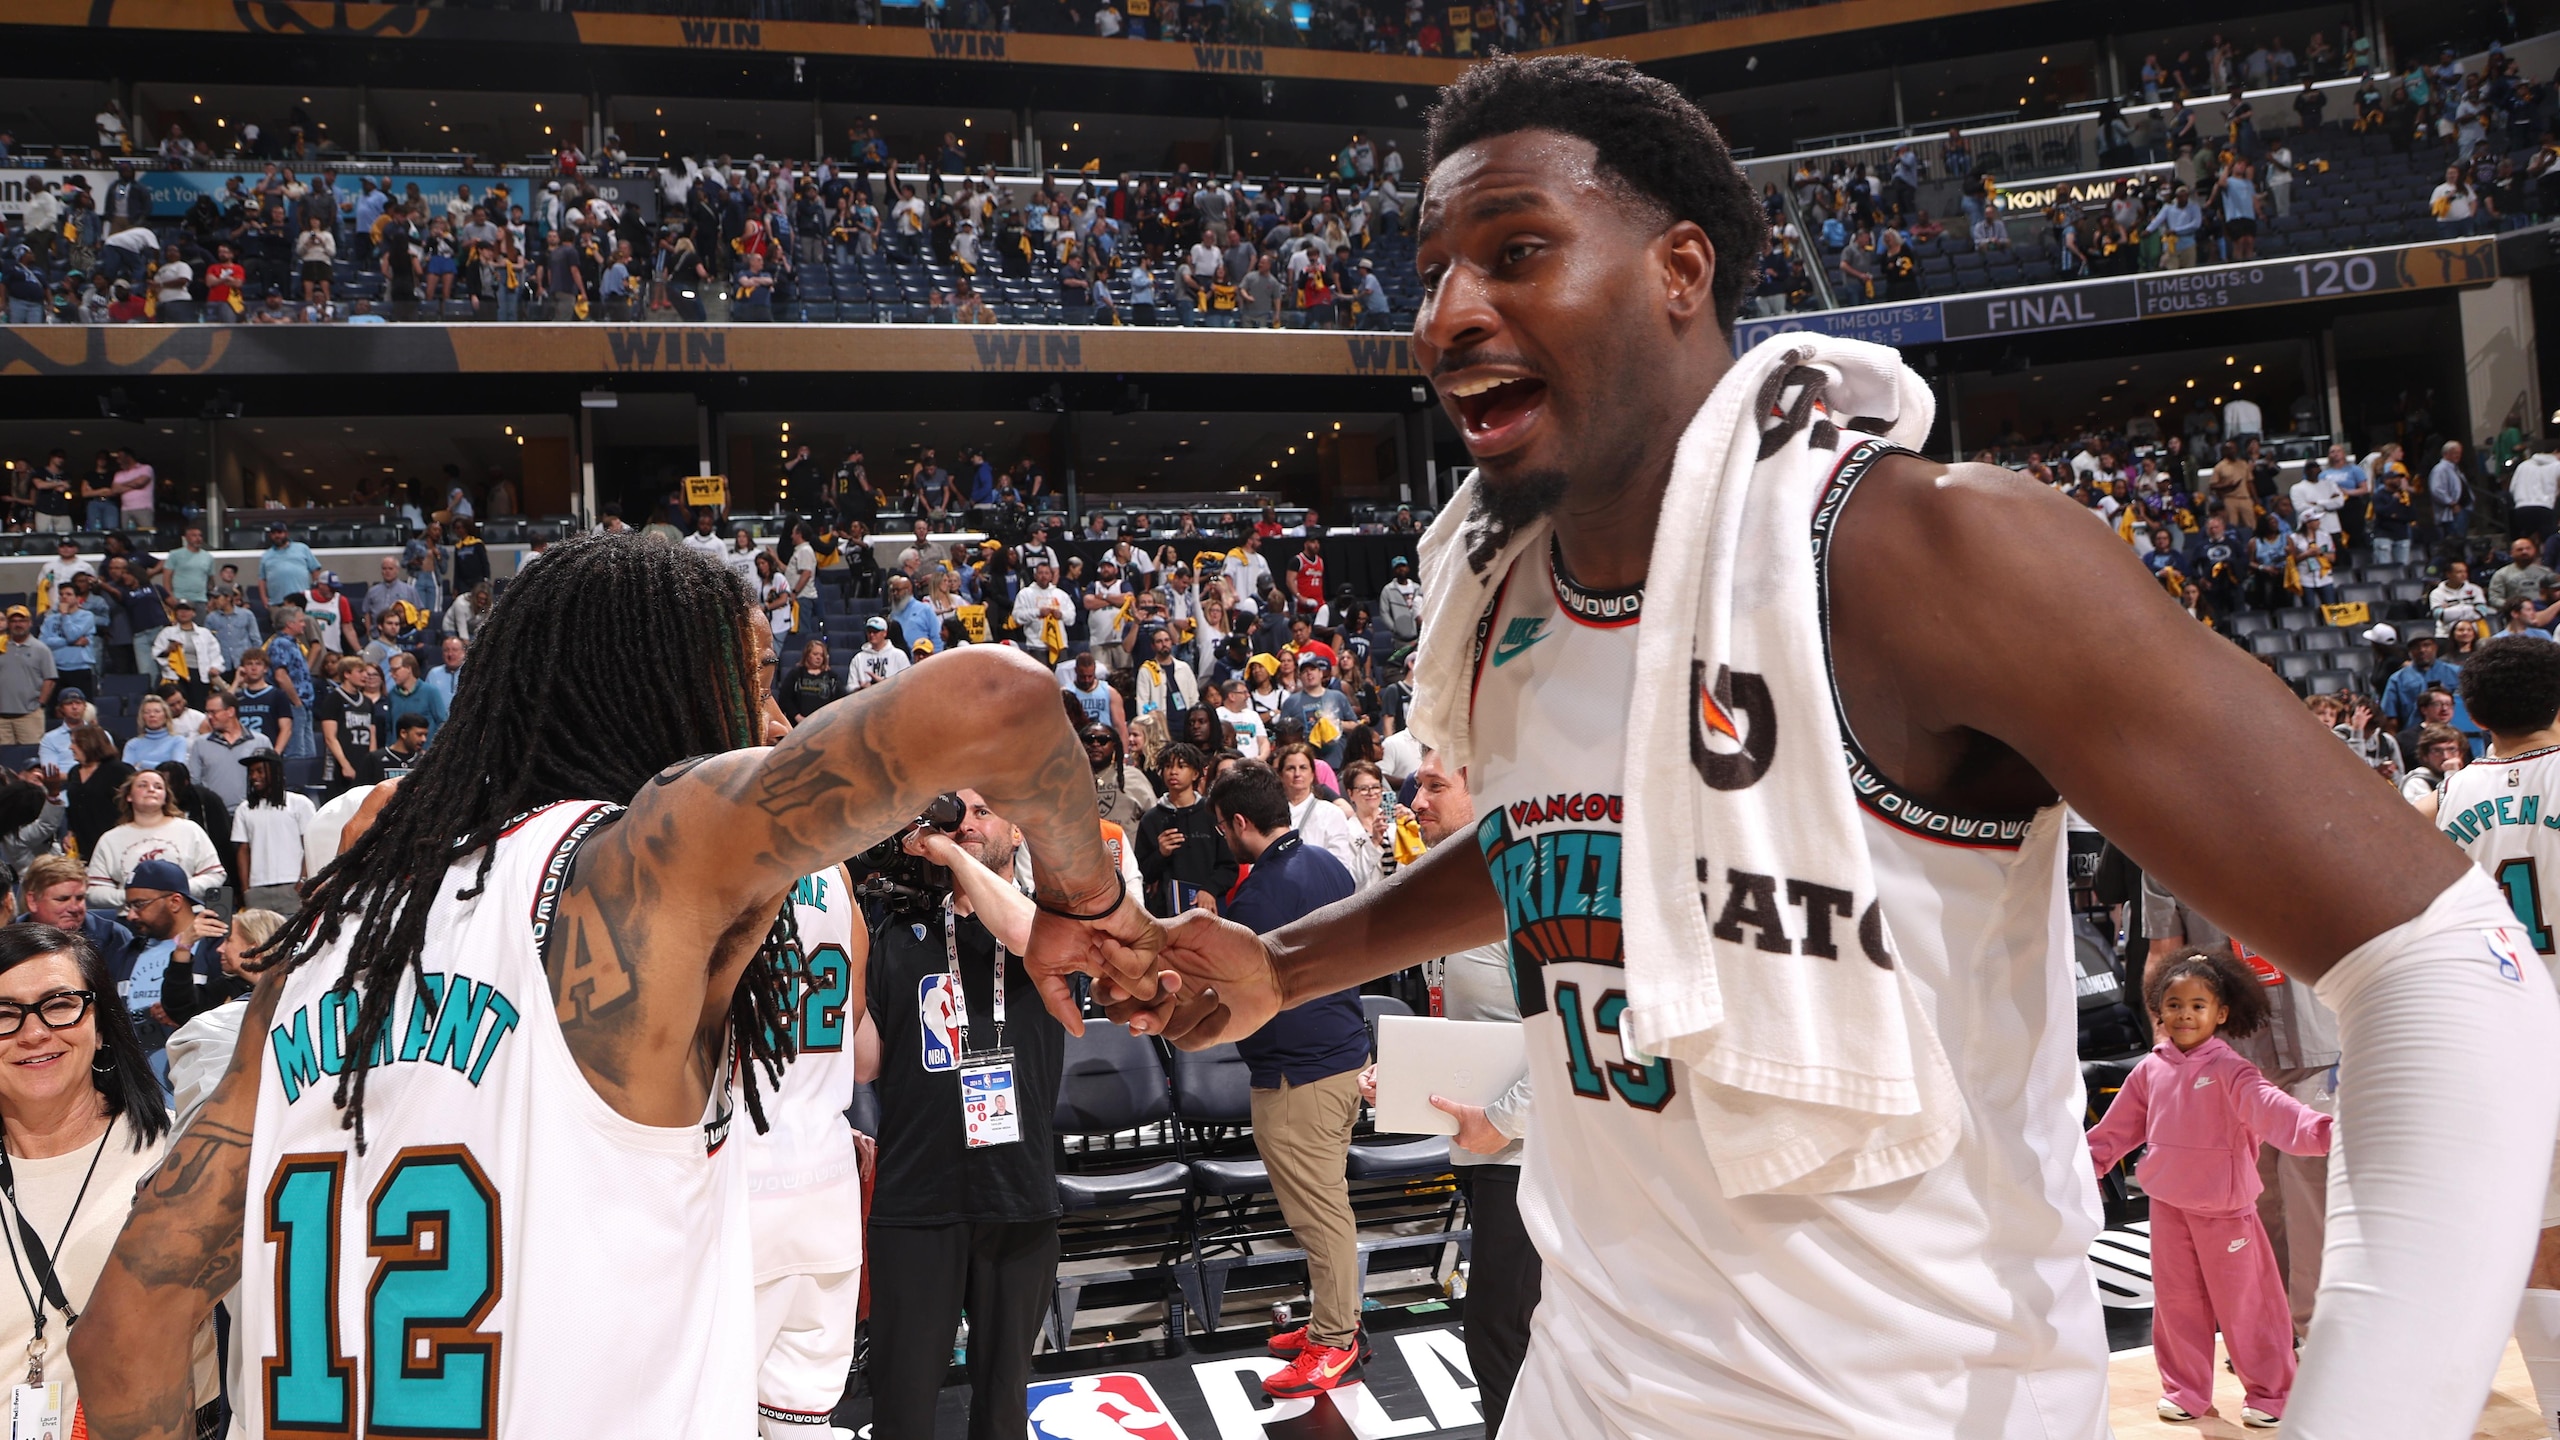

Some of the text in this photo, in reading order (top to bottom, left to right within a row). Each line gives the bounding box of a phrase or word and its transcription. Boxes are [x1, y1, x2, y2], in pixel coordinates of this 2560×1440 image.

[681, 20, 760, 47] WIN
[930, 32, 1005, 58] WIN
[1195, 46, 1264, 72] WIN
[2008, 184, 2084, 211] KONIA
[2146, 268, 2264, 295] TIMEOUTS: 0
[2294, 256, 2377, 297] 120
[1987, 292, 2095, 330] FINAL
[2148, 290, 2228, 313] FOULS: 5
[1825, 306, 1934, 331] TIMEOUTS: 2
[1891, 327, 1903, 342] 5
[606, 332, 725, 365] WIN
[972, 334, 1081, 365] WIN
[1347, 338, 1420, 369] WI
[1502, 617, 1547, 645] NIKE
[351, 729, 370, 745] 12
[1510, 793, 1623, 830] VANCOU
[2495, 857, 2556, 955] 1
[927, 1048, 947, 1066] NBA
[1554, 980, 1676, 1113] 13
[262, 1143, 502, 1440] 12
